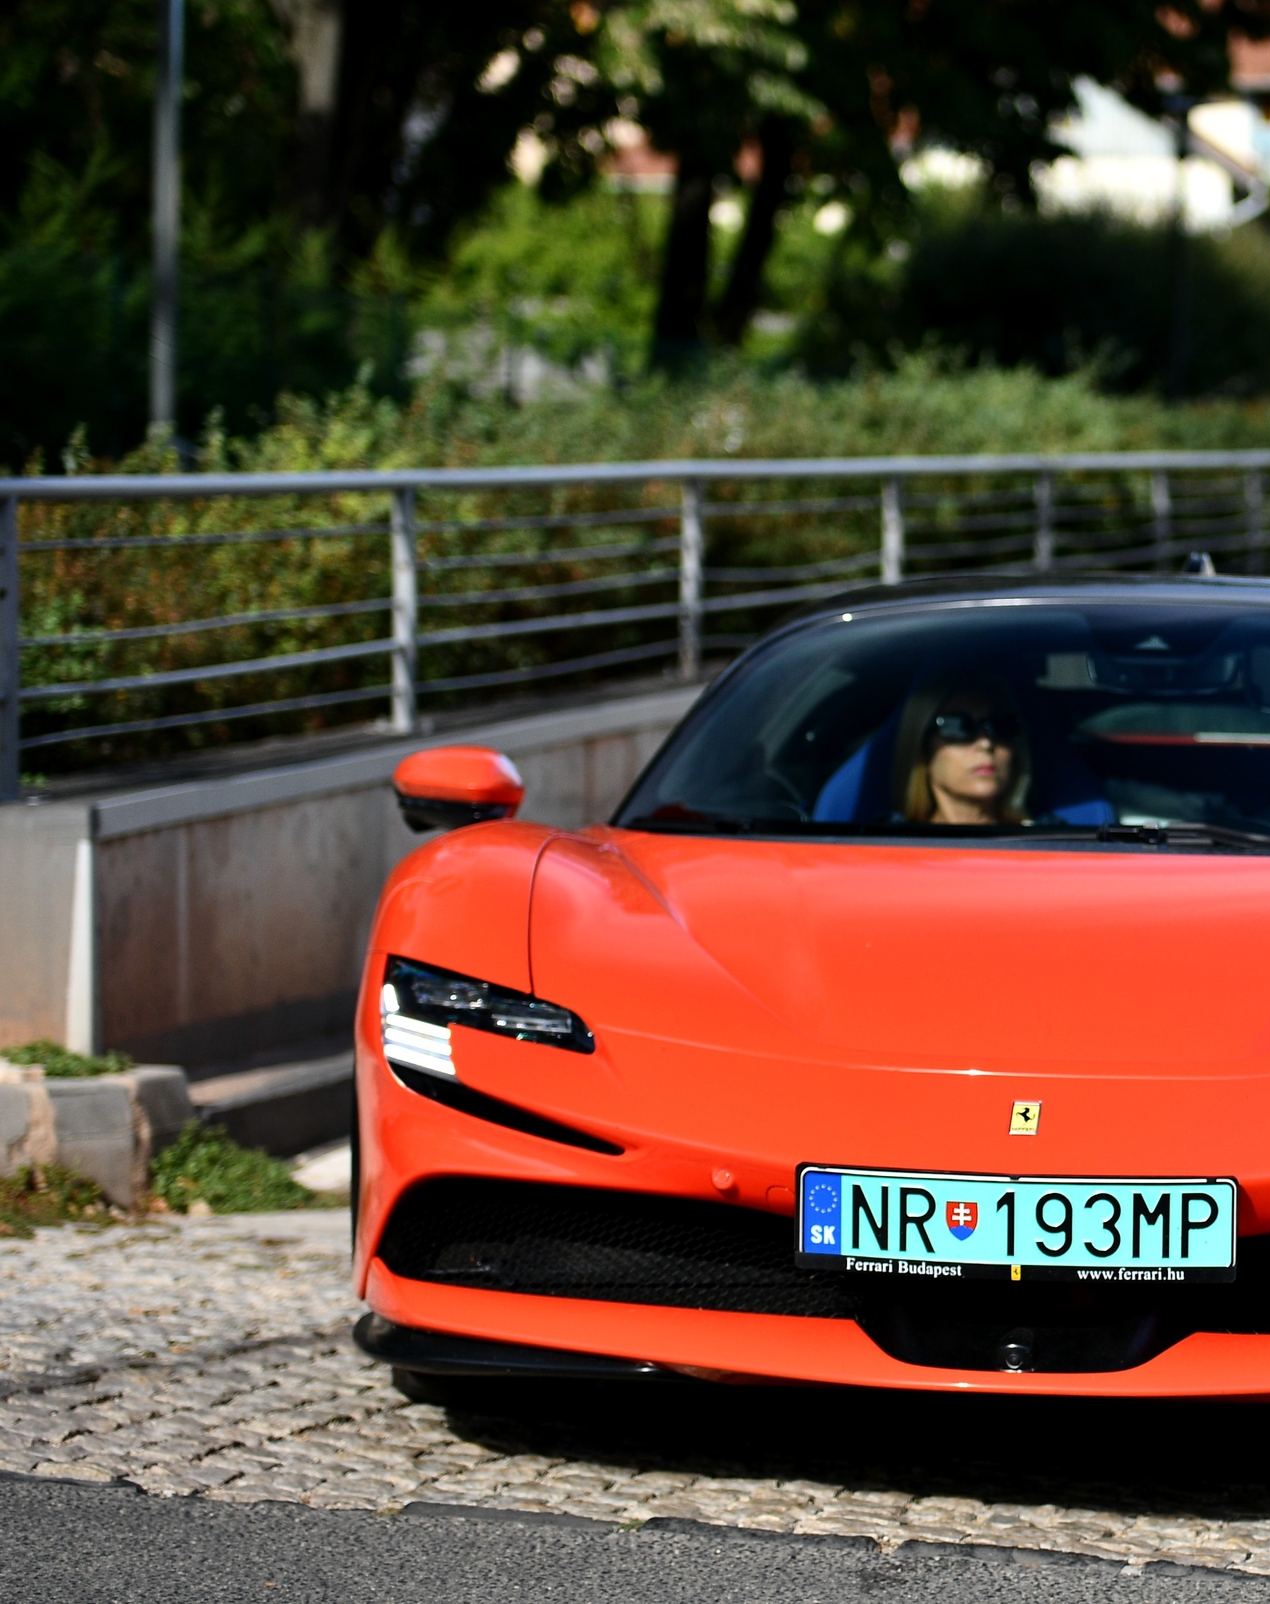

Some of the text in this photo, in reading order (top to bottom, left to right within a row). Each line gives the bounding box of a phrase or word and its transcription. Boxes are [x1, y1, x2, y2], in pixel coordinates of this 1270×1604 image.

[852, 1184, 1219, 1259] NR 193MP
[811, 1225, 836, 1245] SK
[846, 1256, 962, 1278] Ferrari Budapest
[1077, 1267, 1185, 1281] www.ferrari.hu
